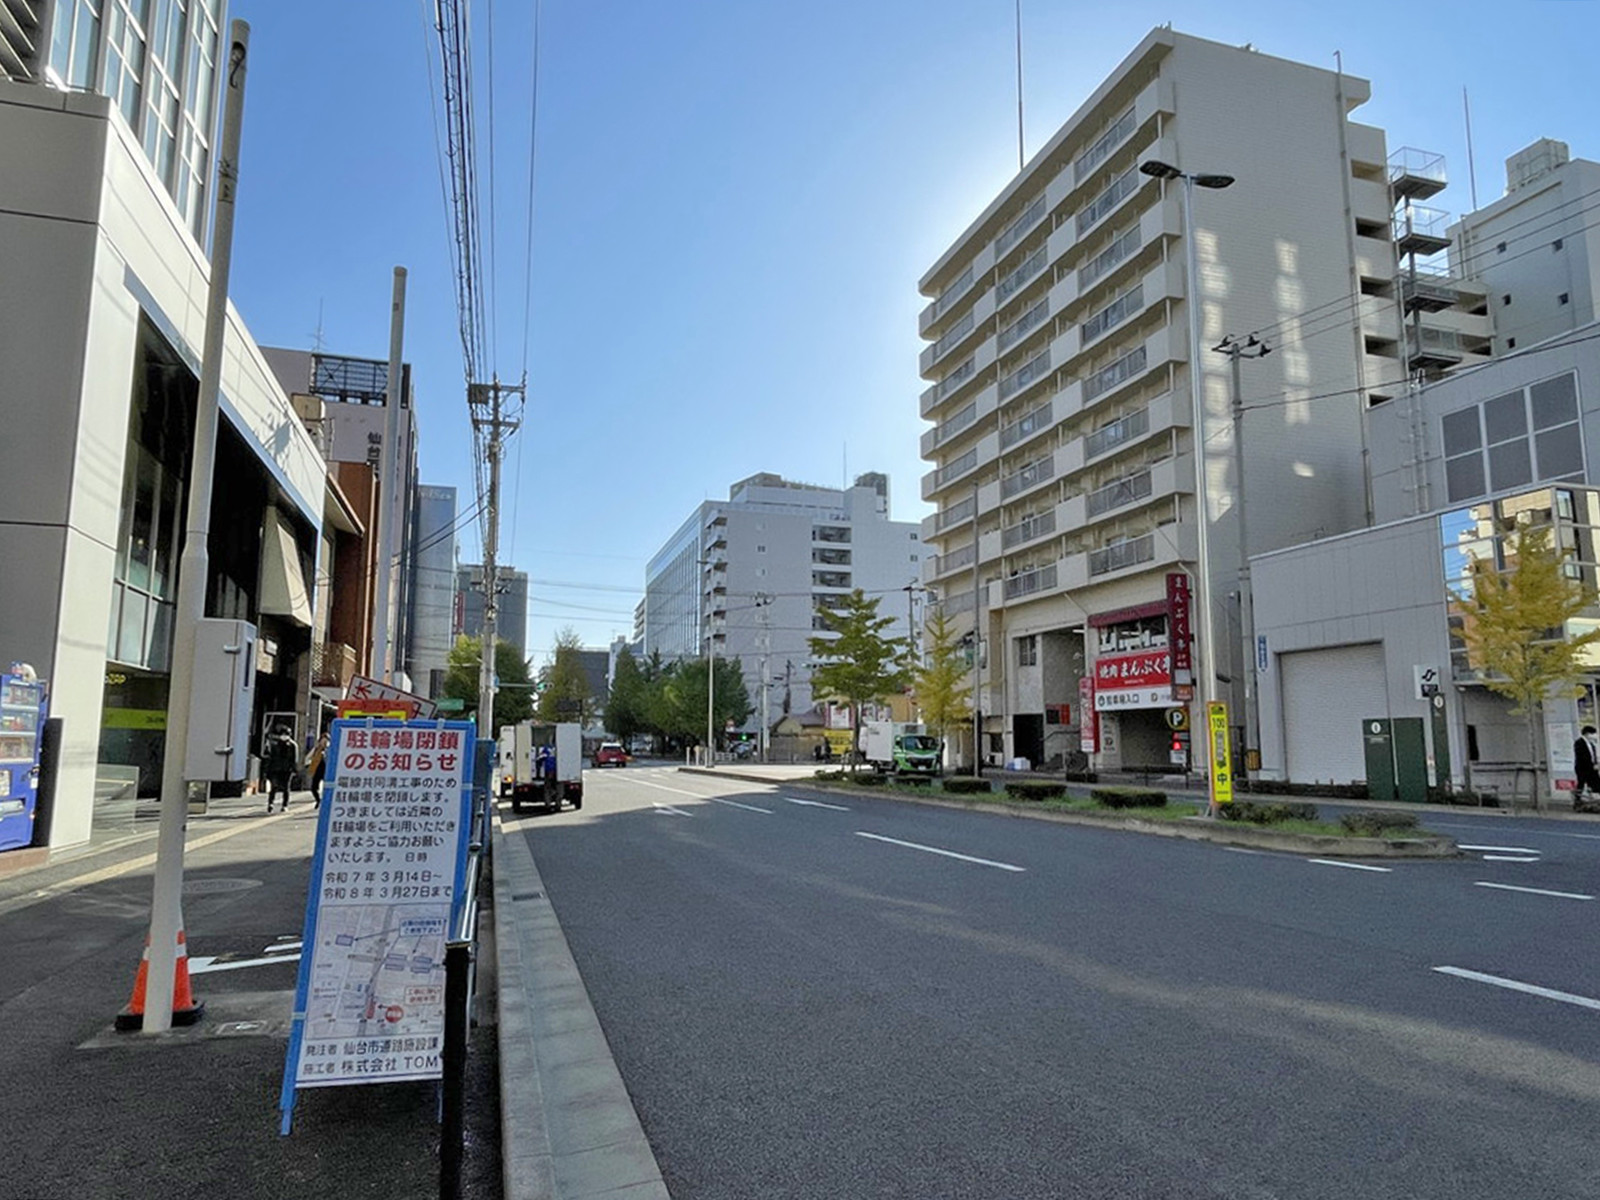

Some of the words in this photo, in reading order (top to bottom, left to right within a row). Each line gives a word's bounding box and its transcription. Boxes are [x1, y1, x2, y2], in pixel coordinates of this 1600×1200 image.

[1172, 711, 1183, 726] P
[346, 730, 459, 751] 駐輪場閉鎖
[344, 752, 458, 772] のお知らせ
[334, 804, 443, 818] つきましては近隣の
[332, 820, 456, 833] 駐輪場をご利用いただき
[330, 835, 444, 849] ますようご協力お願い
[328, 852, 391, 864] いたします。
[306, 1044, 337, 1057] 発注者
[341, 1058, 397, 1074] 株式会社
